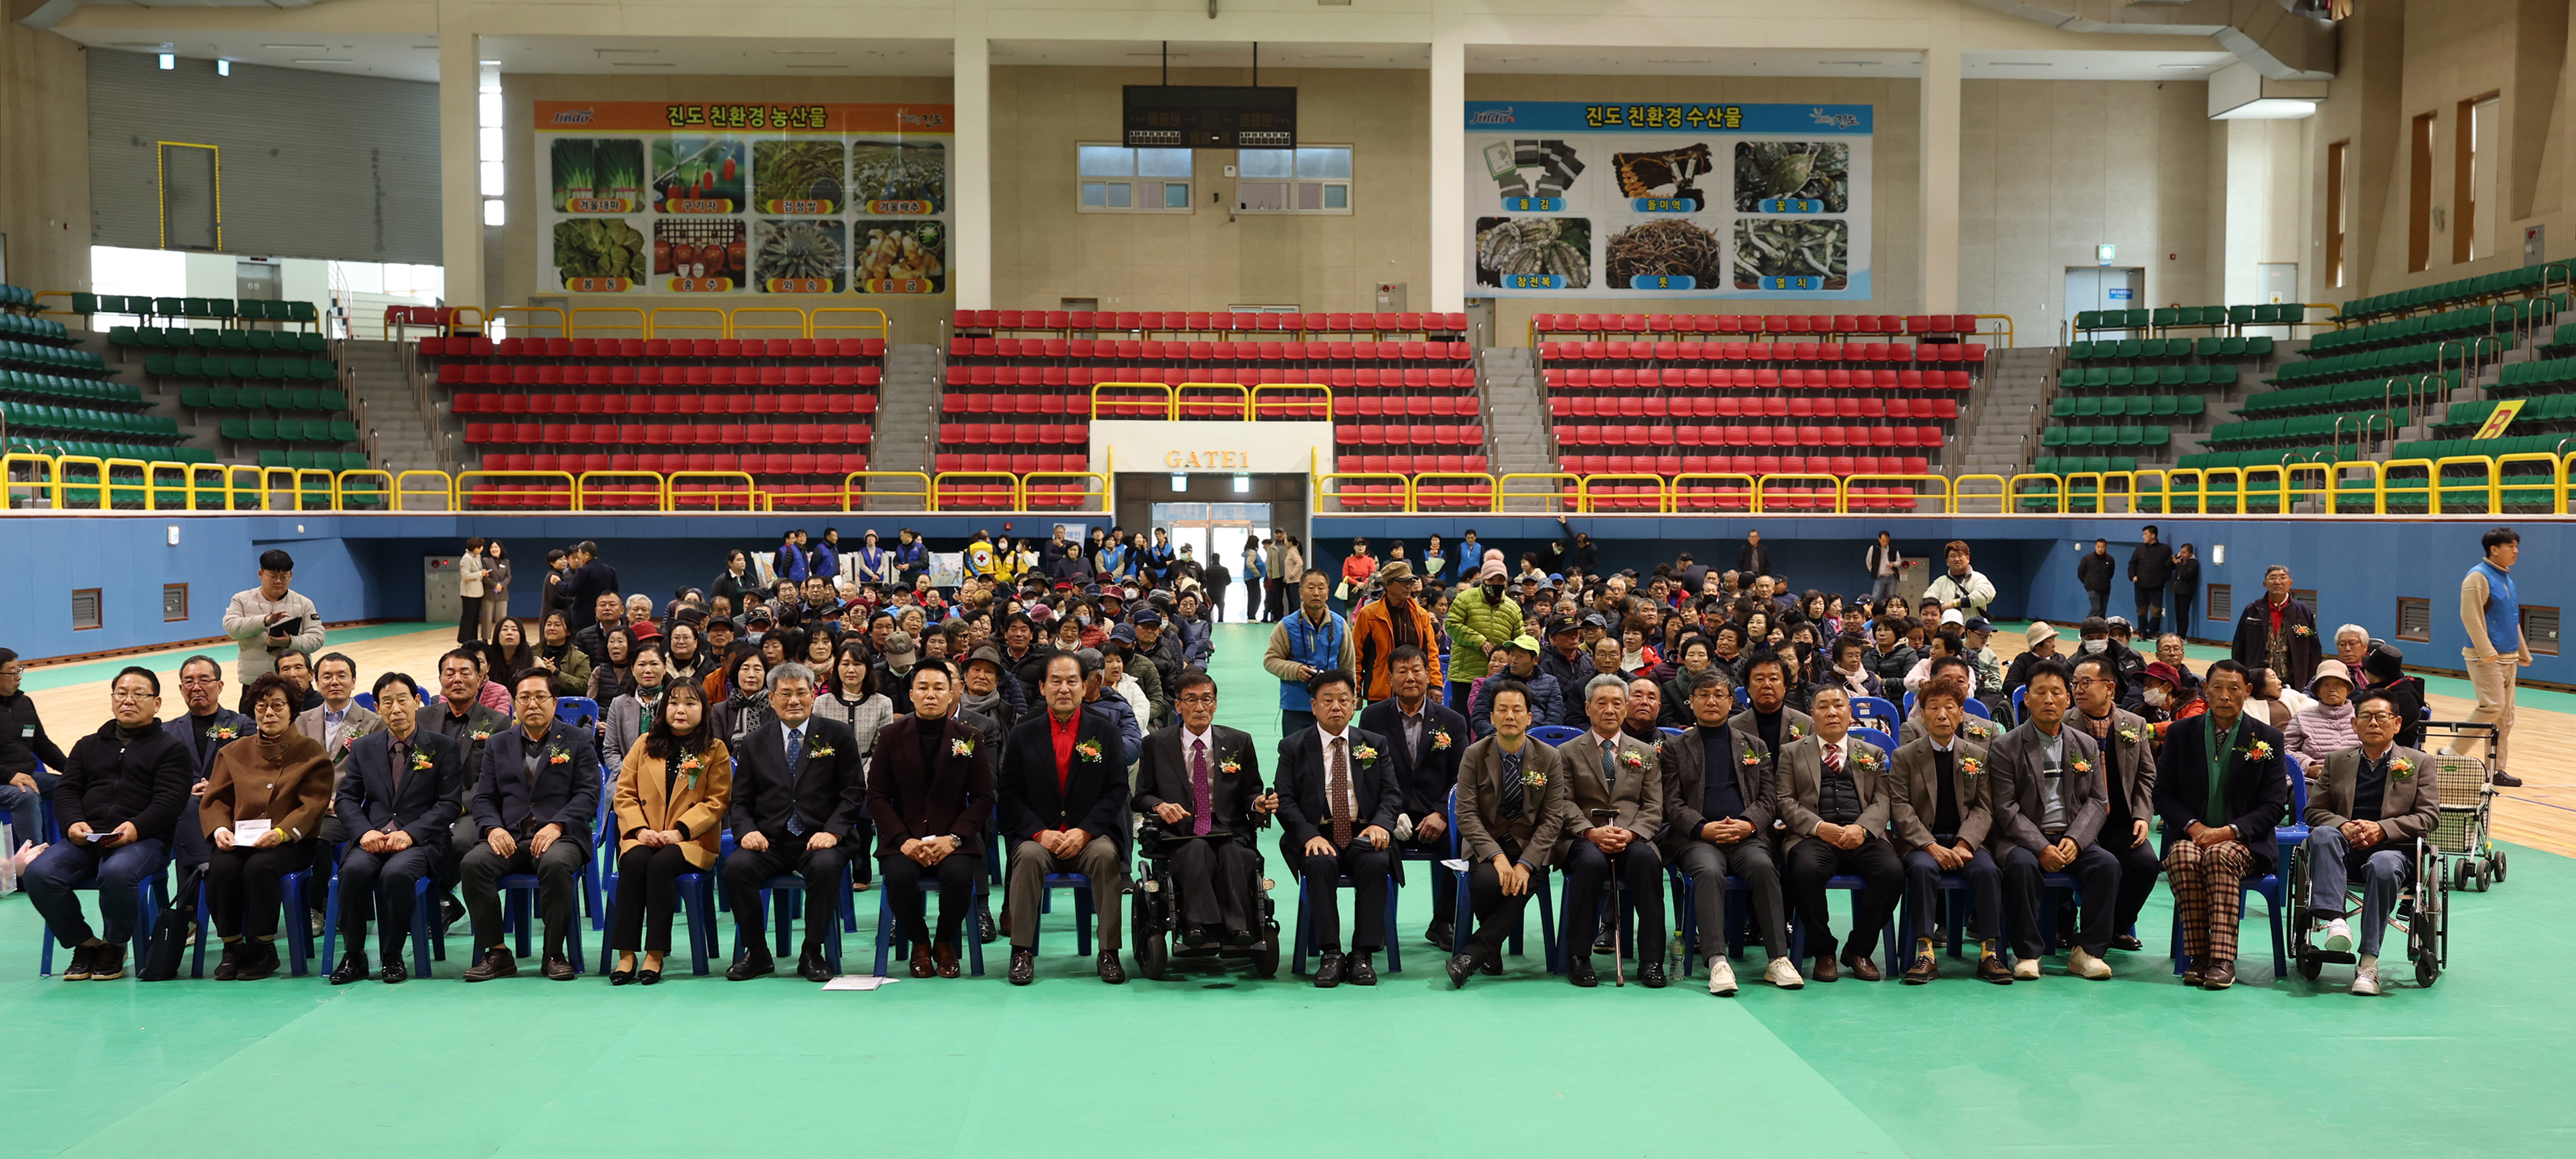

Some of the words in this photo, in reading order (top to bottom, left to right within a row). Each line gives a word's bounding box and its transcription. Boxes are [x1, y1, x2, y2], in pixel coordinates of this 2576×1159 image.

[551, 112, 589, 124] Jindo
[668, 106, 705, 127] 진도
[710, 106, 764, 128] 친환경
[770, 106, 827, 128] 농산물
[1469, 112, 1508, 124] Jindo
[1586, 106, 1623, 127] 진도
[1628, 106, 1682, 128] 친환경
[1686, 106, 1742, 128] 수산물
[579, 200, 619, 212] 겨울대파
[682, 201, 717, 212] 구기자
[784, 202, 817, 212] 검정쌀
[879, 202, 920, 213] 겨울배추
[1647, 200, 1680, 211] 돌미역
[1517, 277, 1551, 288] 참전복
[1659, 277, 1669, 288] 톳
[1165, 450, 1249, 468] GATE1
[1066, 530, 1081, 540] 애인
